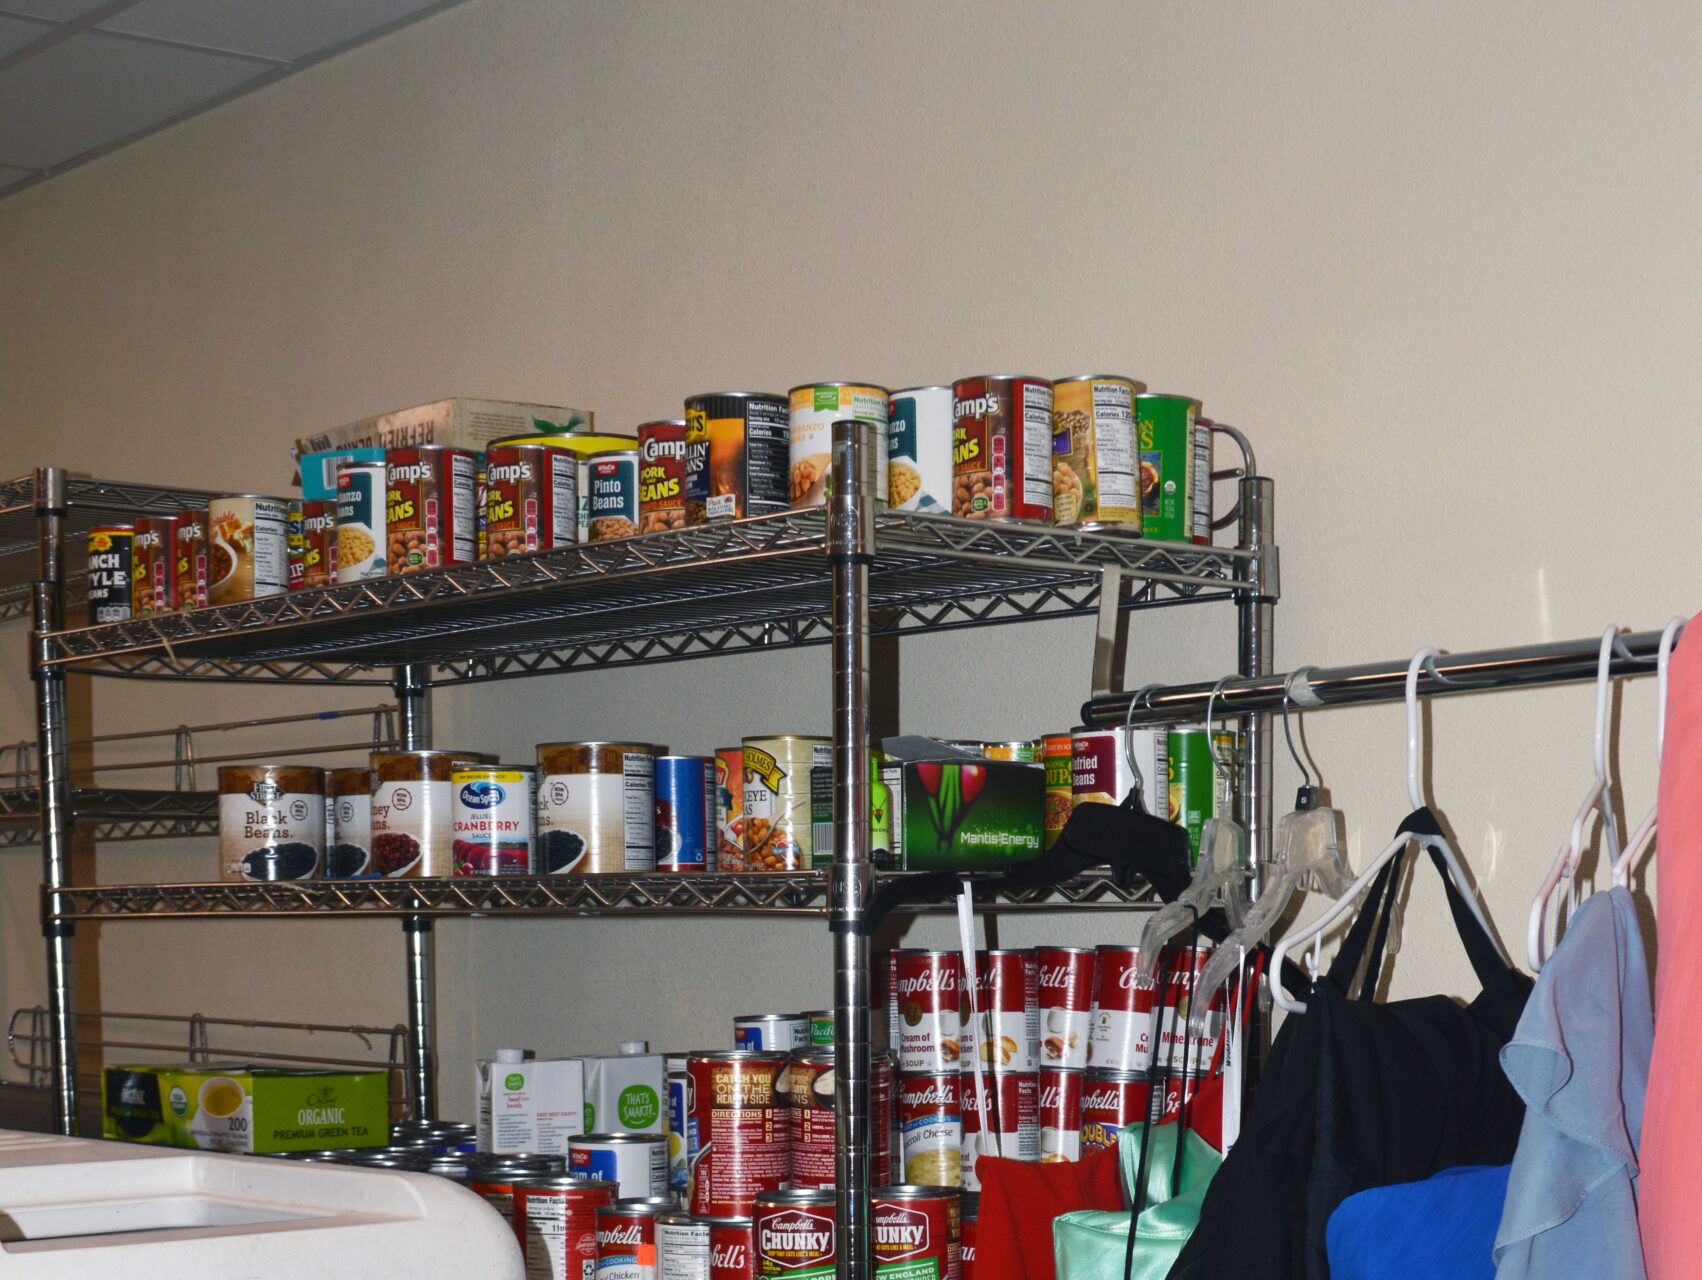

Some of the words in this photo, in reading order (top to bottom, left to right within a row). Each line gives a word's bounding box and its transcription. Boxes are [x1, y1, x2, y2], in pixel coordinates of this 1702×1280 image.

[594, 479, 621, 495] Pinto
[592, 495, 624, 511] Beans
[461, 790, 481, 804] Ocean
[246, 812, 287, 826] Black
[453, 821, 520, 833] CRANBERRY
[960, 831, 998, 846] Mantis
[1001, 831, 1039, 849] Energy
[752, 1074, 771, 1084] YOU
[625, 1091, 651, 1105] THAT'S
[750, 1093, 771, 1104] SIDE
[298, 1107, 345, 1126] ORGANIC
[711, 1110, 763, 1119] DIRECTIONS
[228, 1117, 248, 1132] 200
[273, 1127, 315, 1141] PREMIUM
[318, 1126, 349, 1138] GREEN
[351, 1125, 369, 1137] TEA
[771, 1216, 815, 1233] Campbell's
[761, 1229, 831, 1253] CHUNKY
[605, 1255, 637, 1266] COOKING
[890, 1266, 935, 1280] ENGLAND
